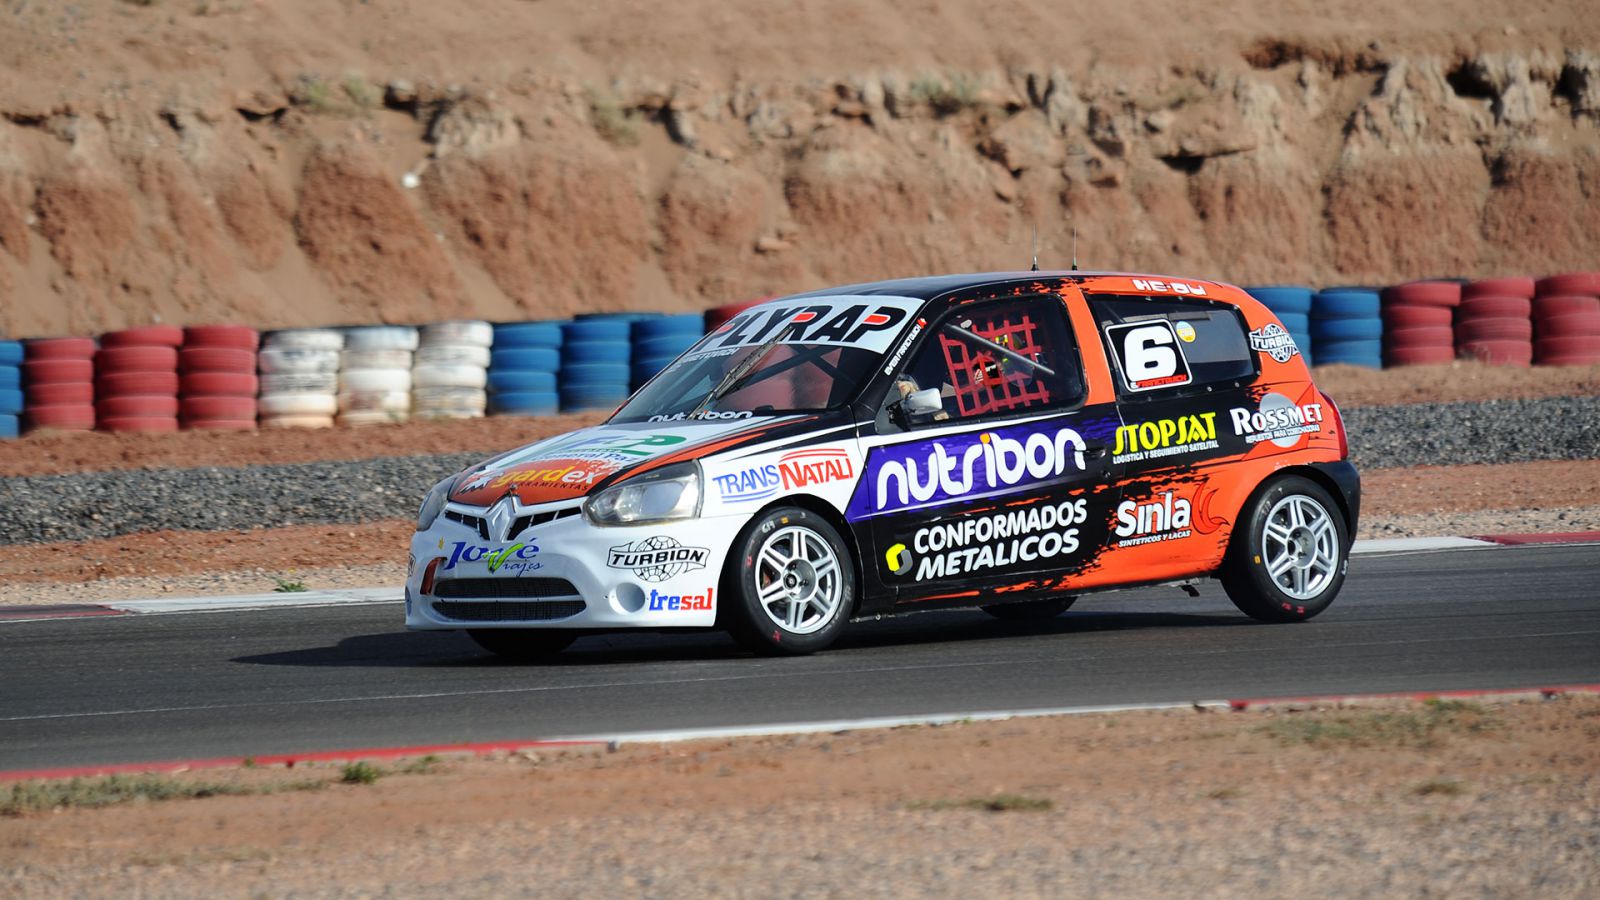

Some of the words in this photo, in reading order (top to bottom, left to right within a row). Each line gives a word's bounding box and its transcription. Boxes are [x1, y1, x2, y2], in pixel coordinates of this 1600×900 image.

[1124, 326, 1177, 381] 6
[648, 410, 753, 423] nutibon
[1112, 412, 1216, 455] STOPSAT
[877, 428, 1087, 510] nutribon
[1113, 453, 1144, 464] LOGISTICA
[491, 465, 600, 489] gardex
[914, 498, 1088, 554] CONFORMADOS
[612, 549, 704, 566] TURBION
[915, 528, 1080, 582] METALICOS
[649, 588, 713, 611] tresal
